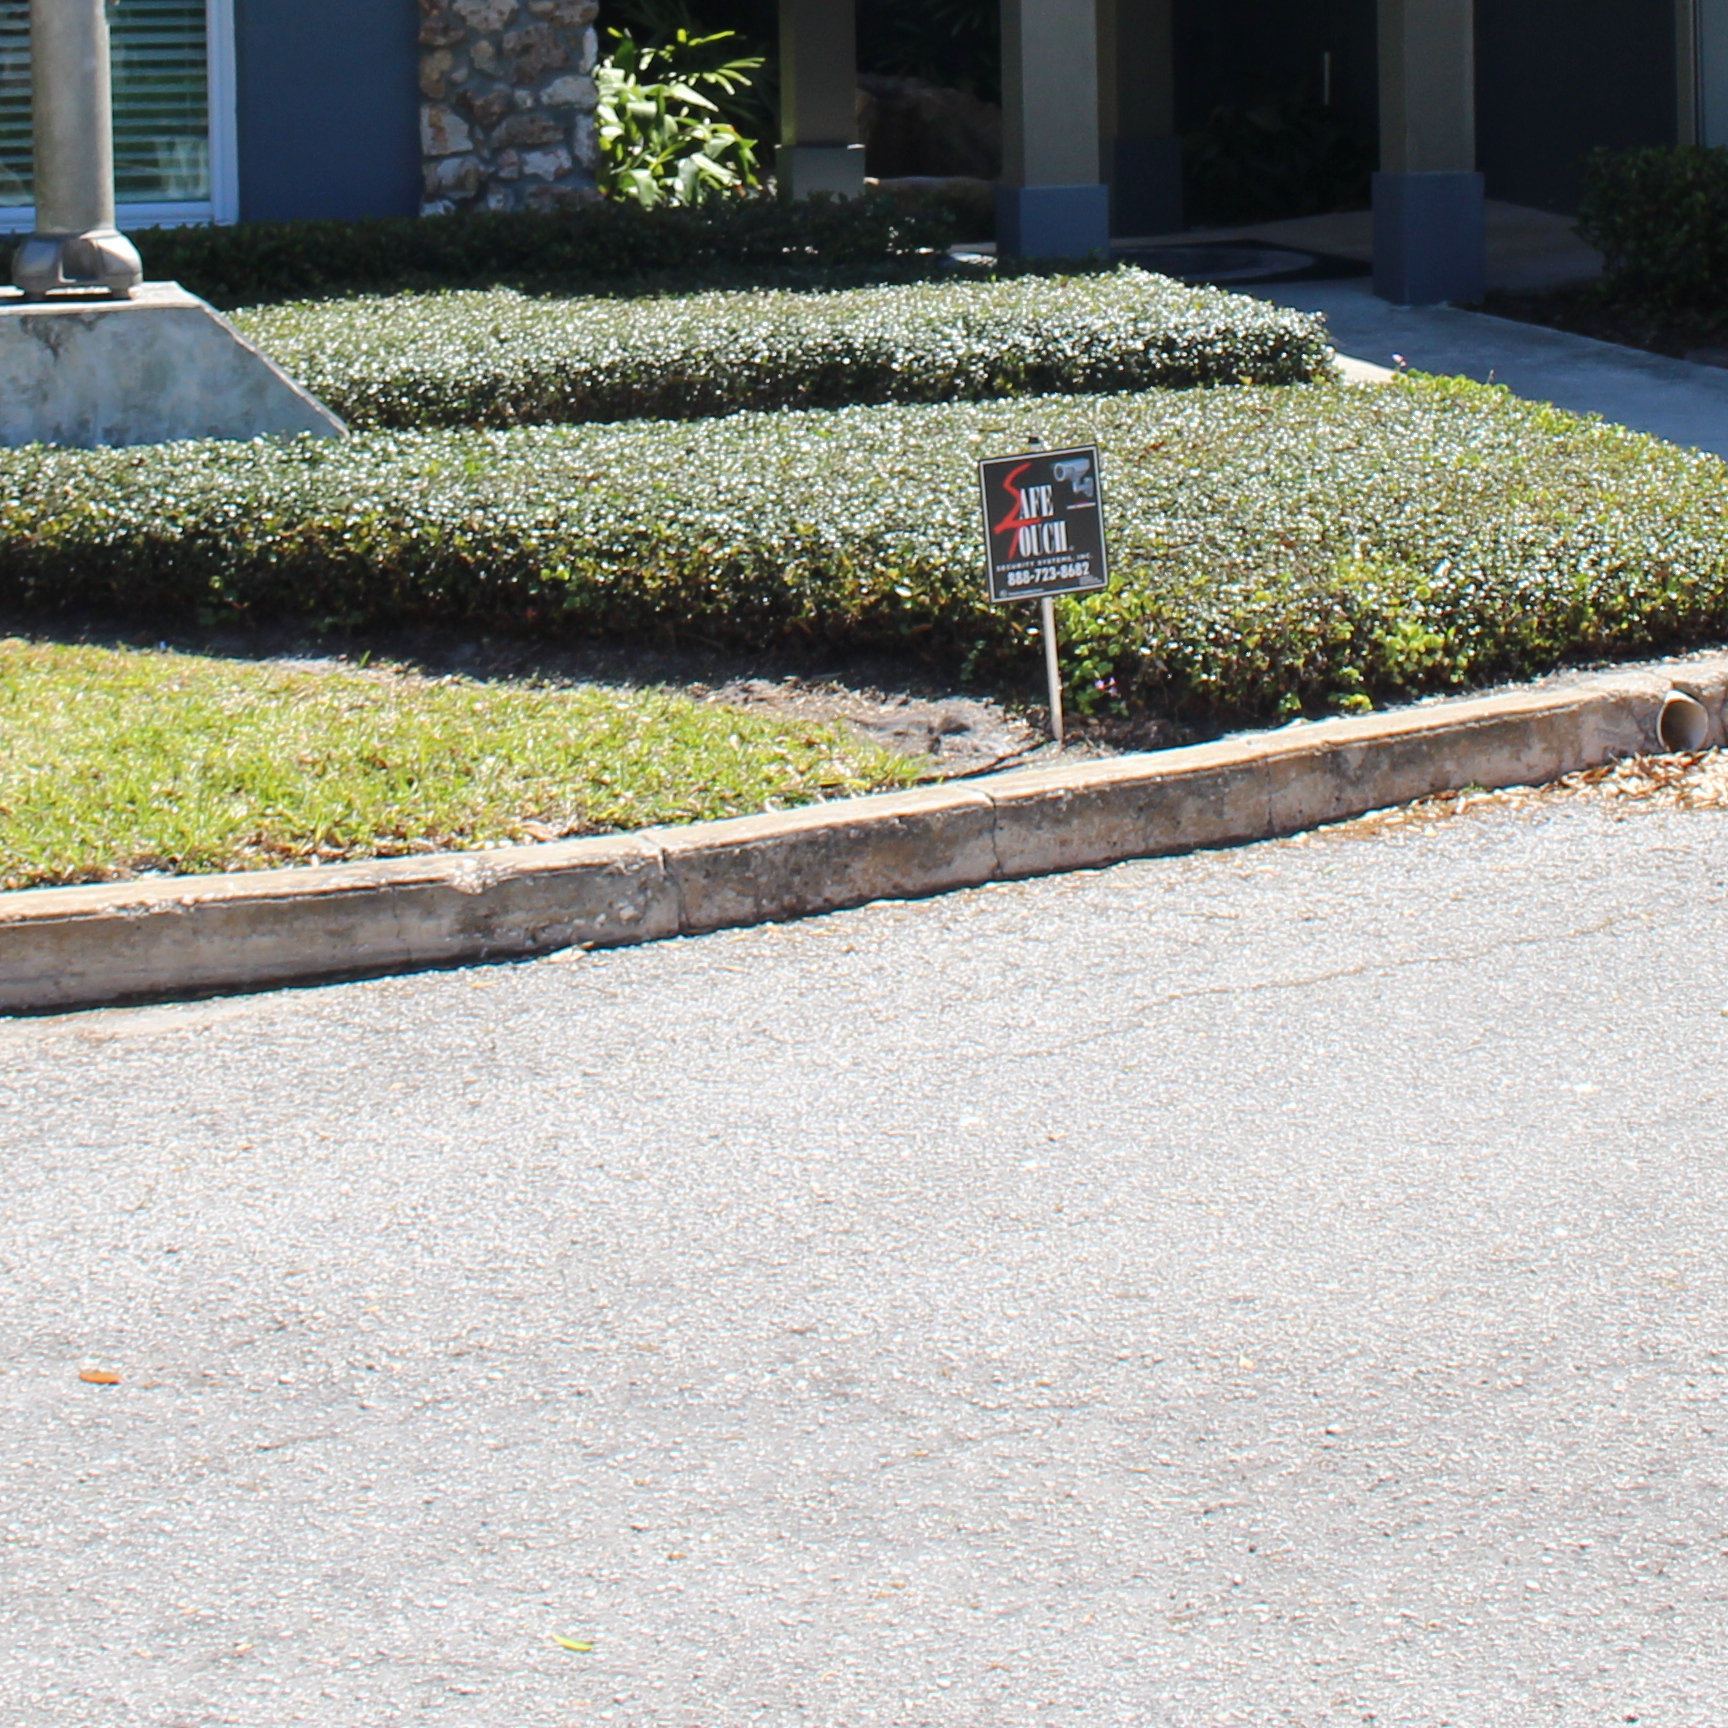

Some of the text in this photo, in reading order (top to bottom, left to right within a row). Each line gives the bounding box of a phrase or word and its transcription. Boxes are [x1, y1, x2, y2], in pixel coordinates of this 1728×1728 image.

[994, 462, 1054, 534] SAFE
[994, 518, 1068, 559] TOUCH
[996, 561, 1035, 572] SECURITY
[1007, 561, 1090, 587] 888-723-8682
